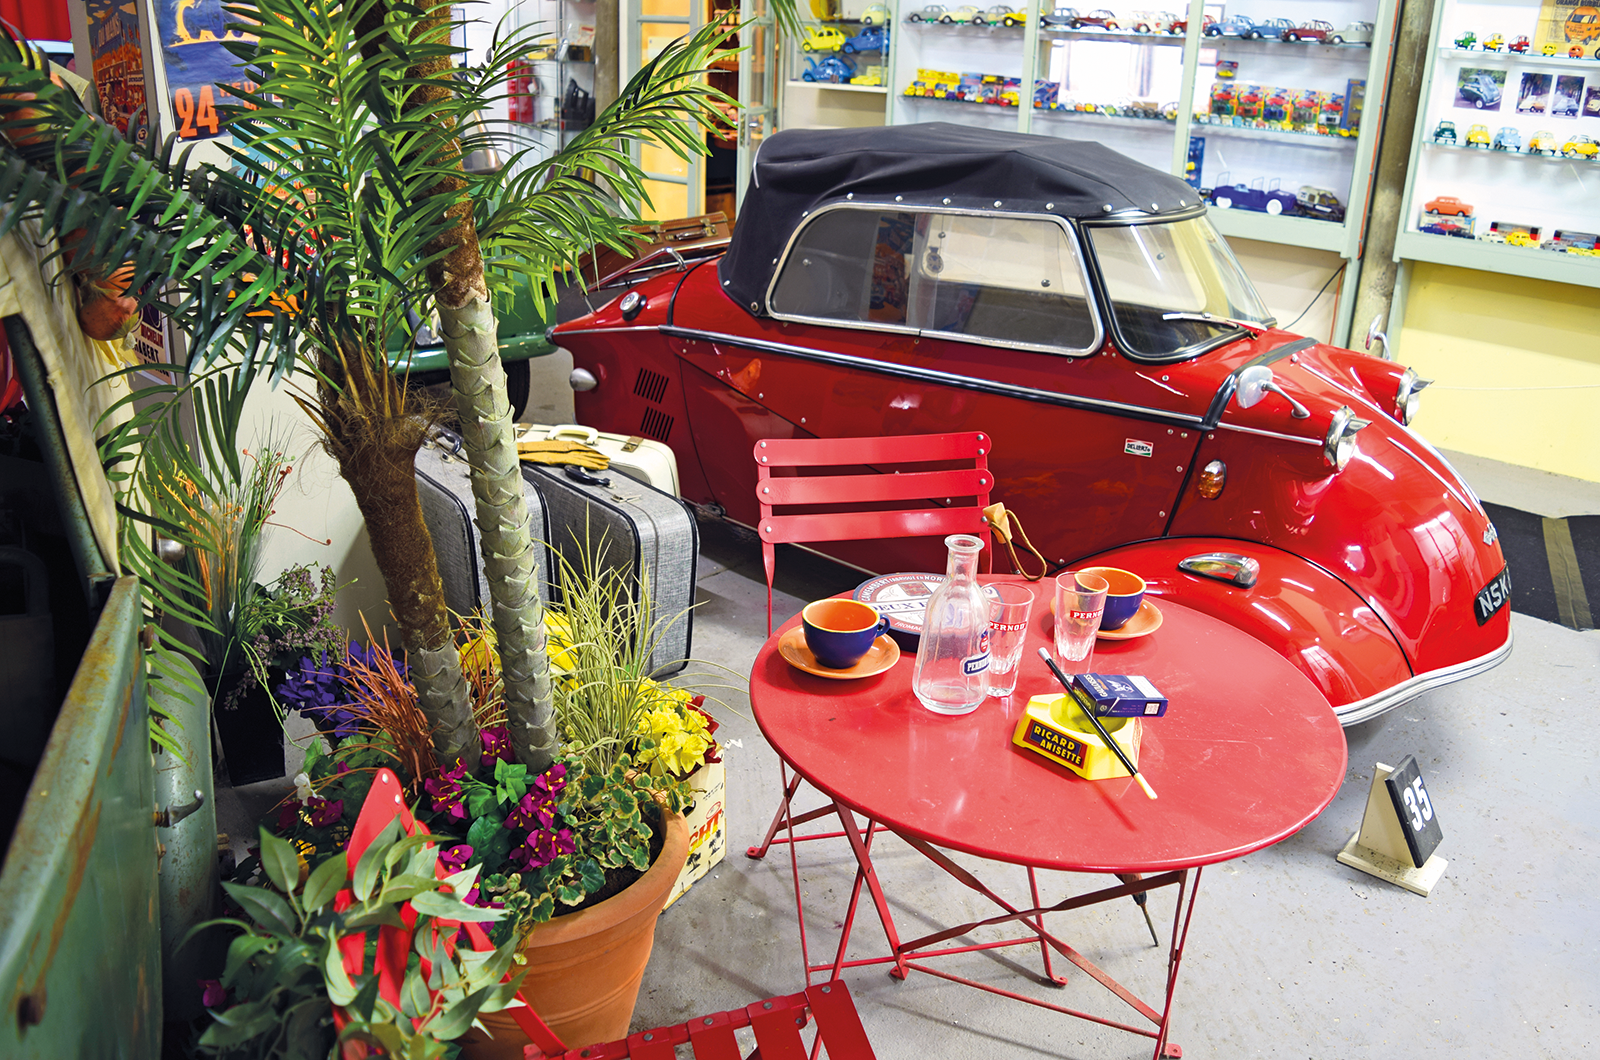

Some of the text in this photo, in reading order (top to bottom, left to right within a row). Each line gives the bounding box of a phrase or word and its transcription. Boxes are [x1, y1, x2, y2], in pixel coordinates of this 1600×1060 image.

[175, 85, 219, 138] 24
[861, 578, 890, 602] CAMEMBERT
[1479, 566, 1511, 617] NSK
[1034, 725, 1075, 750] RICARD
[1040, 739, 1082, 765] ANISETTE
[1403, 775, 1434, 832] 35
